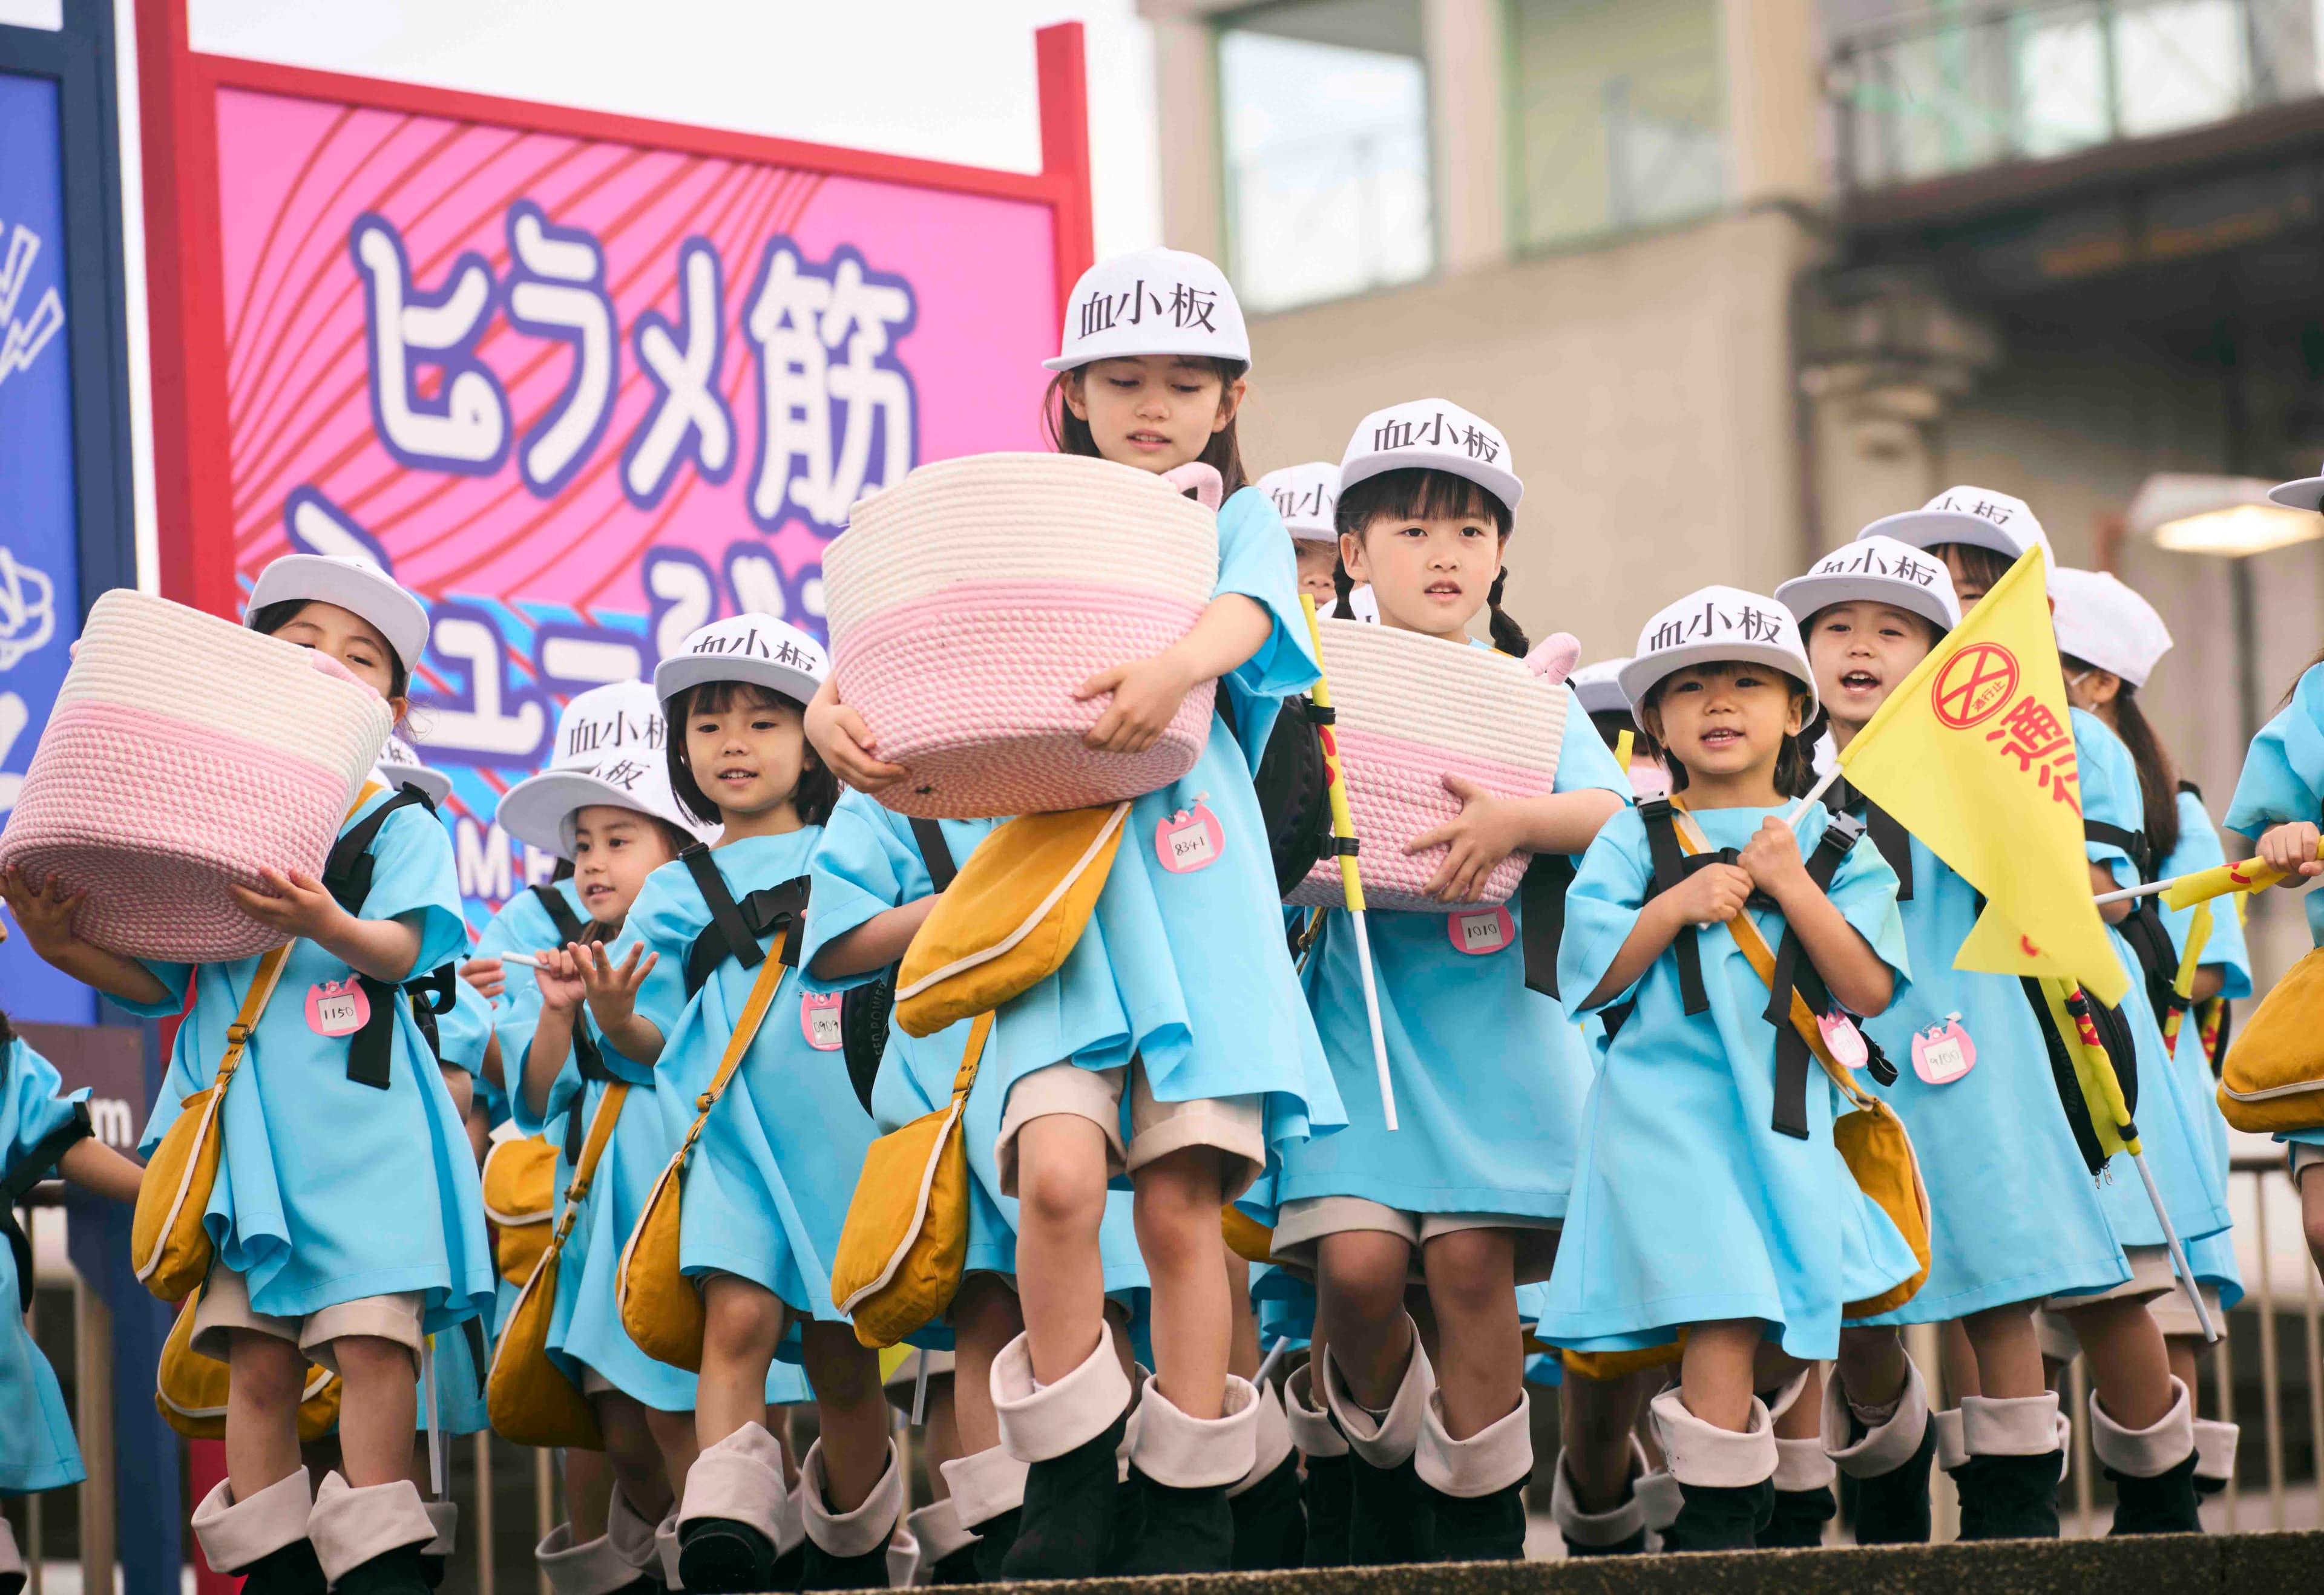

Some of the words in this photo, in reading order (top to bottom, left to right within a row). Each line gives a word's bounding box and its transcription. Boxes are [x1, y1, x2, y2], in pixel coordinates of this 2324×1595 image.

[1078, 280, 1217, 340] 血小板
[356, 207, 913, 529] ヒラメ筋
[1374, 413, 1500, 464] 血小板
[1270, 483, 1333, 518] 血小
[1650, 603, 1783, 652] 血小板
[1972, 680, 2006, 713] 通行止
[1174, 836, 1205, 856] 8341
[1468, 923, 1497, 938] 1010
[324, 1006, 354, 1020] 1150
